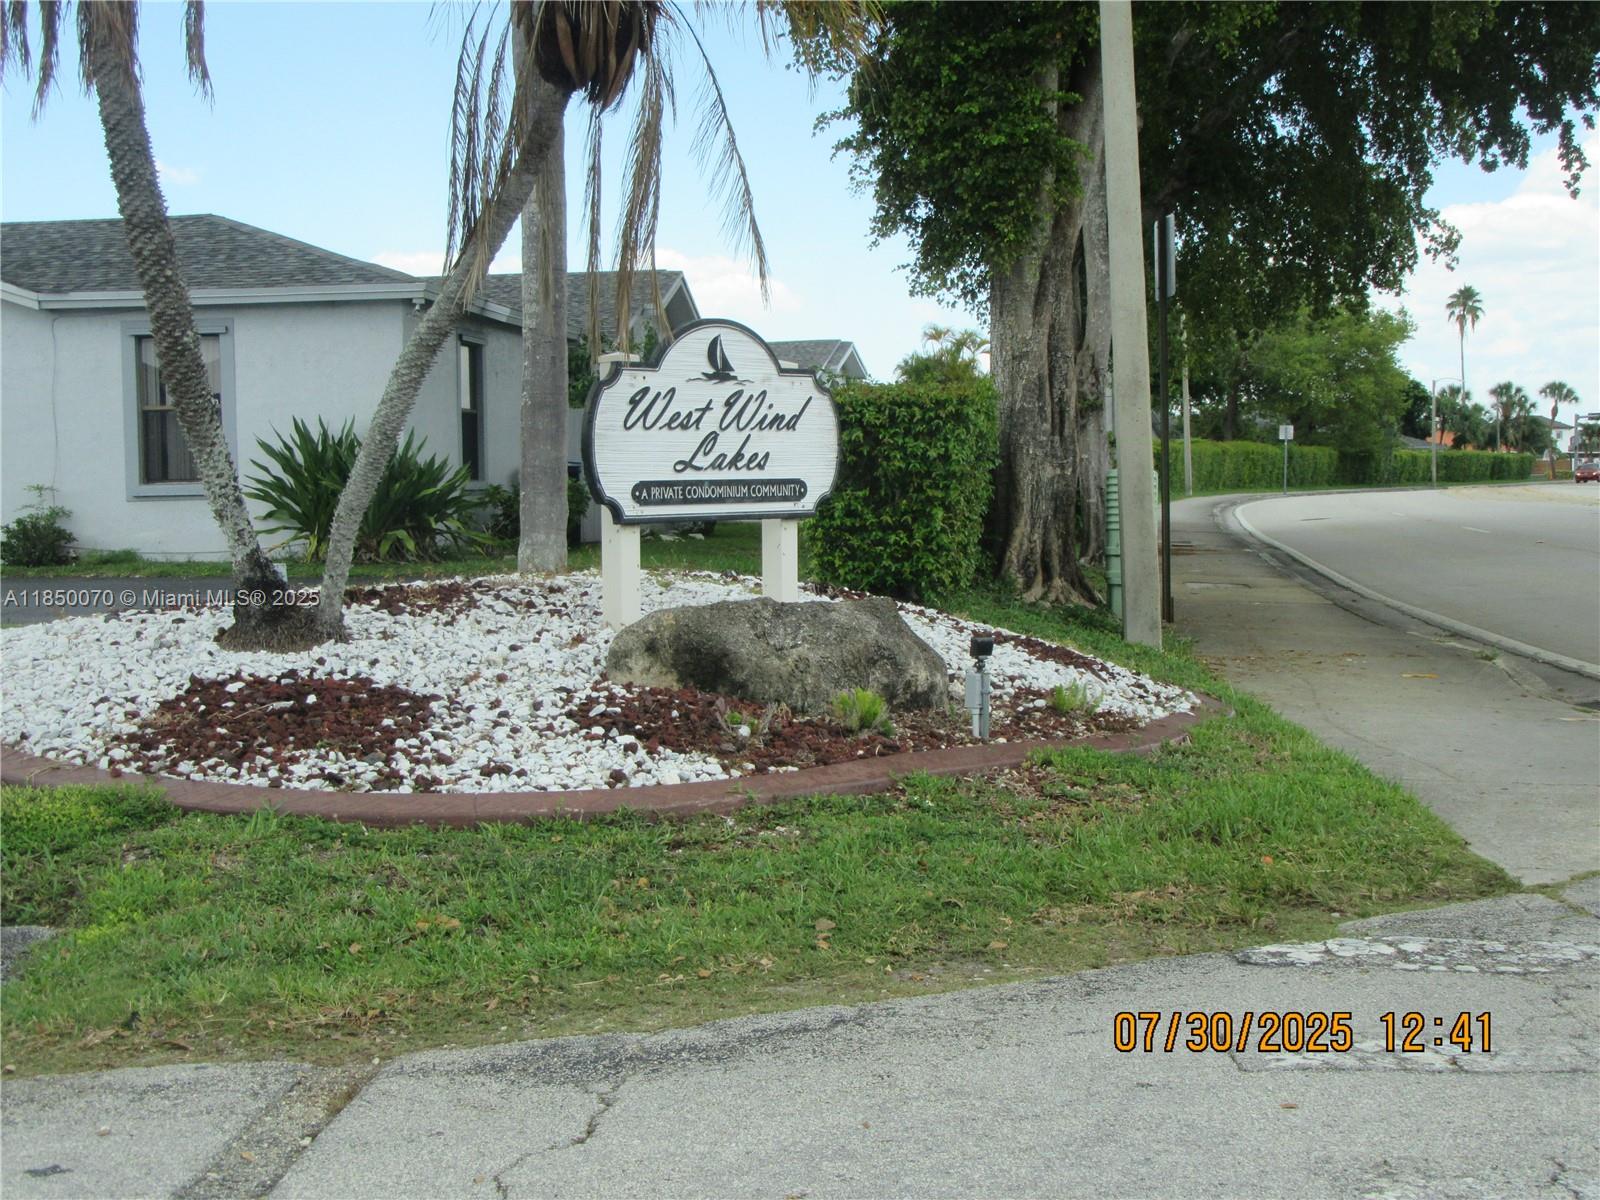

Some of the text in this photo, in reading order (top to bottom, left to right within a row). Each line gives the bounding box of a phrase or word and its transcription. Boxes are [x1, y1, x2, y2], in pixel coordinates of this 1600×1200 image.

[624, 386, 813, 432] West Wind
[673, 430, 770, 473] Lakes
[641, 483, 801, 500] A PRIVATE CONDOMINIUM COMMUNITY
